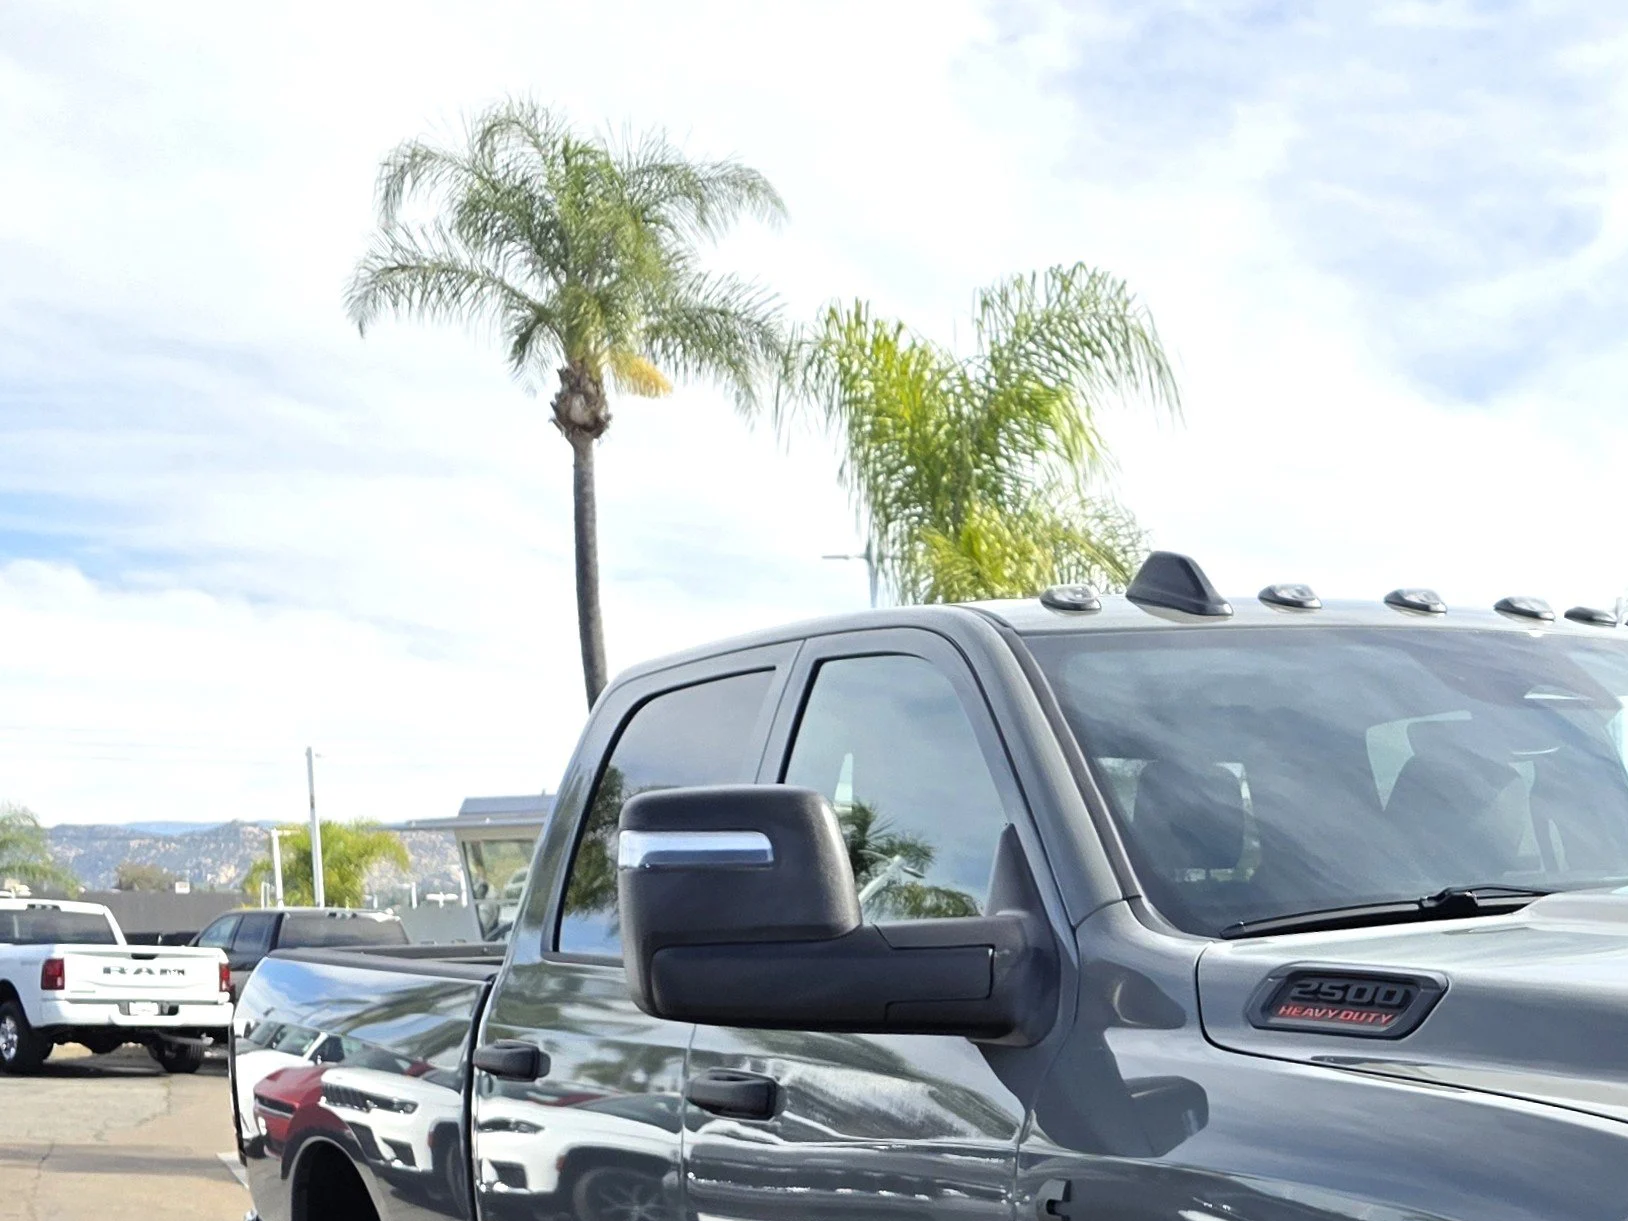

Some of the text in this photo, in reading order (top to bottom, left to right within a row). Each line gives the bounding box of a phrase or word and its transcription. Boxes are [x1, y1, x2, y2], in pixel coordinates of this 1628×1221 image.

[1291, 980, 1407, 1007] 2500
[1278, 1005, 1394, 1024] HEAVY DUTY
